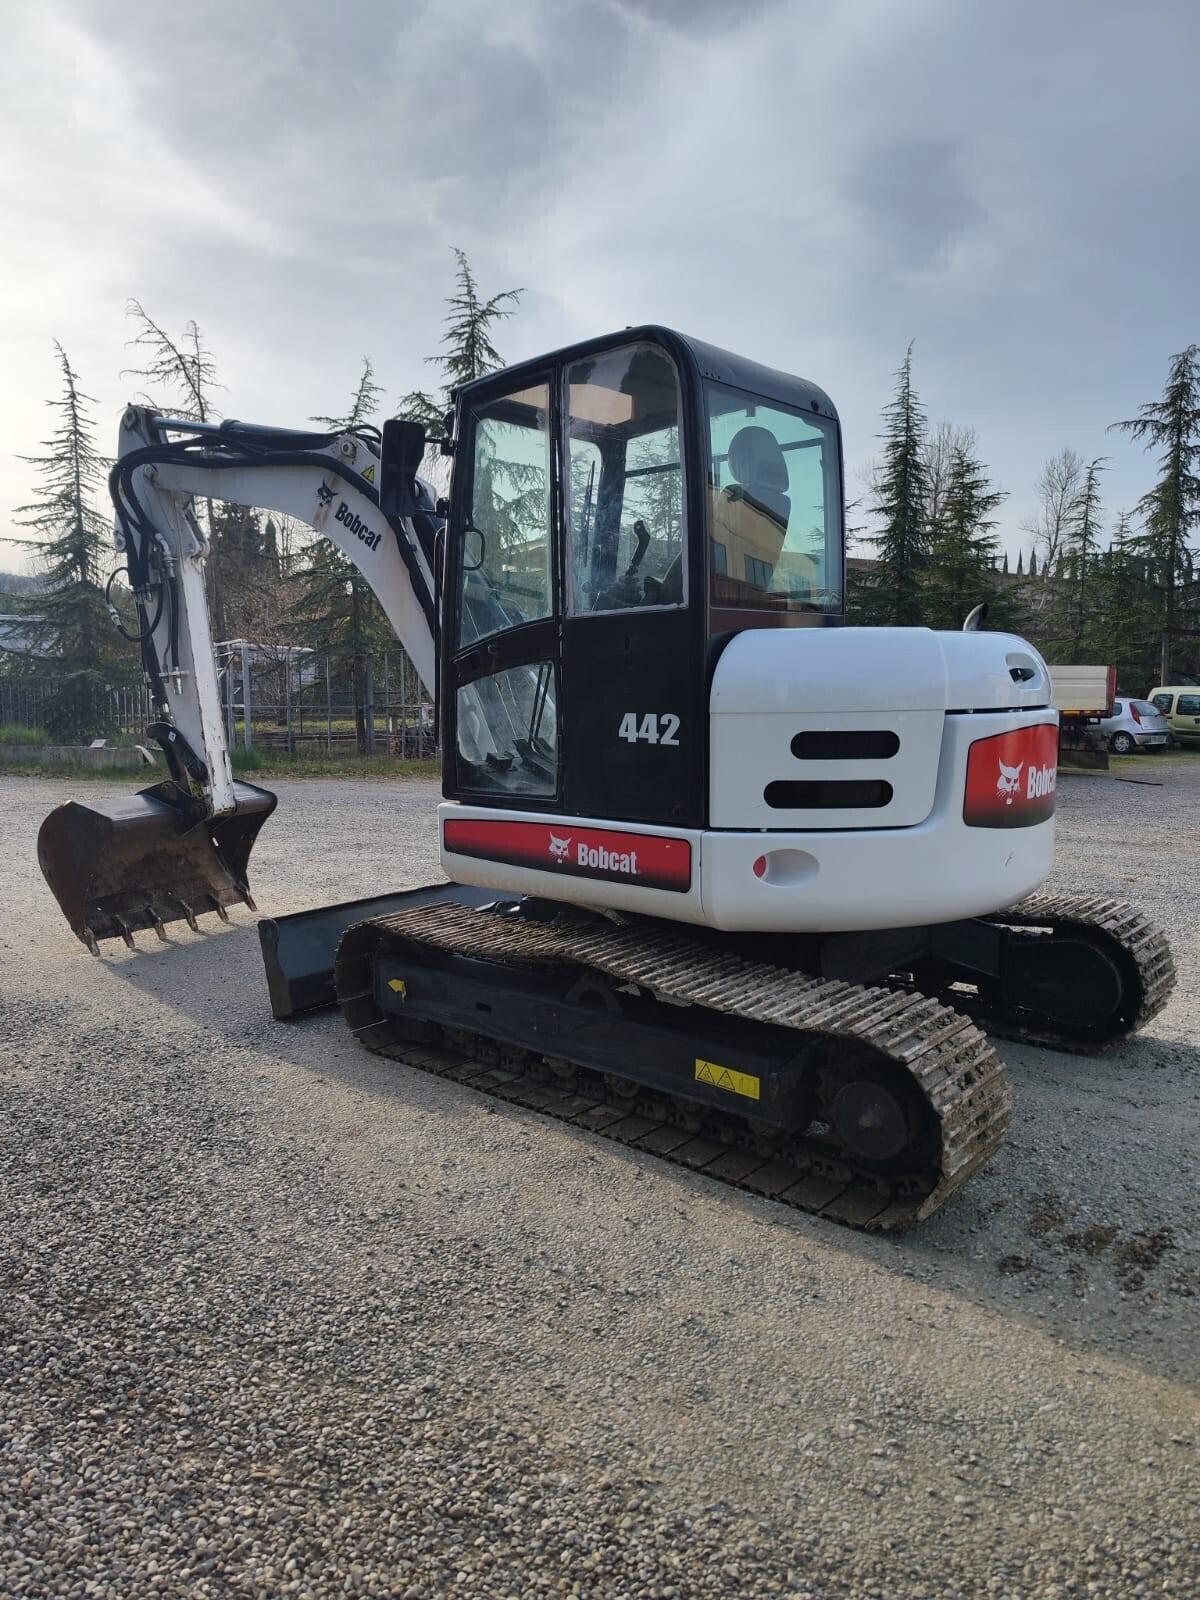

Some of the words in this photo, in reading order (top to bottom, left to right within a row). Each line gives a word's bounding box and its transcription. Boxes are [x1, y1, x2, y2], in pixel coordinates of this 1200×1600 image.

[335, 502, 382, 552] Bobcat
[618, 712, 680, 746] 442
[1026, 763, 1057, 800] Bobca
[577, 842, 637, 874] Bobcat
